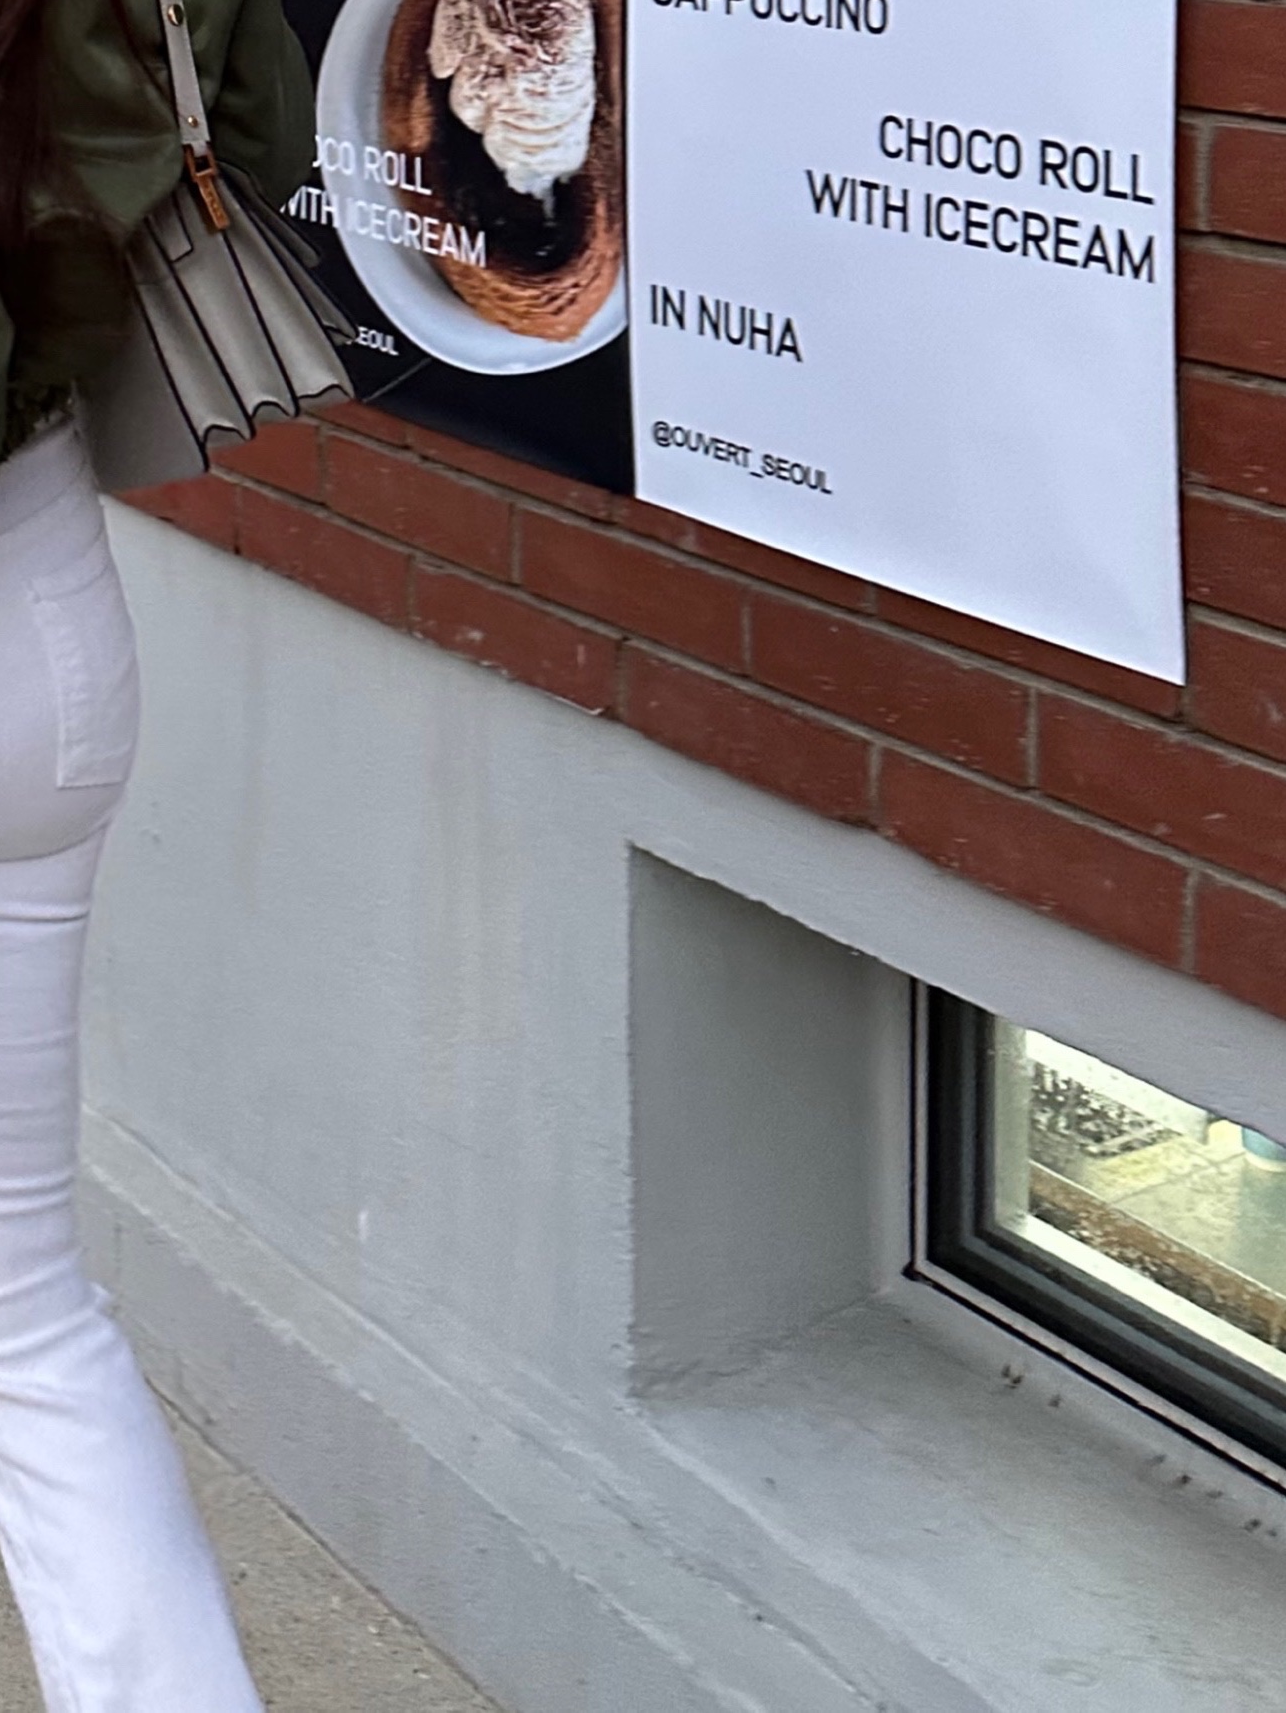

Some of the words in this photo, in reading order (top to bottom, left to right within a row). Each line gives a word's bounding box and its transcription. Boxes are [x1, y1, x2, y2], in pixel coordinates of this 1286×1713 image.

[364, 146, 432, 195] ROLL
[880, 115, 1022, 180] CHOCO
[1040, 139, 1155, 205] ROLL
[346, 197, 487, 268] ICECREAM
[805, 169, 909, 233] WITH
[924, 193, 1155, 284] ICECREAM
[651, 284, 686, 331] IN
[698, 295, 802, 363] NUHA
[652, 421, 832, 495] @OUVERT_SEOUL
